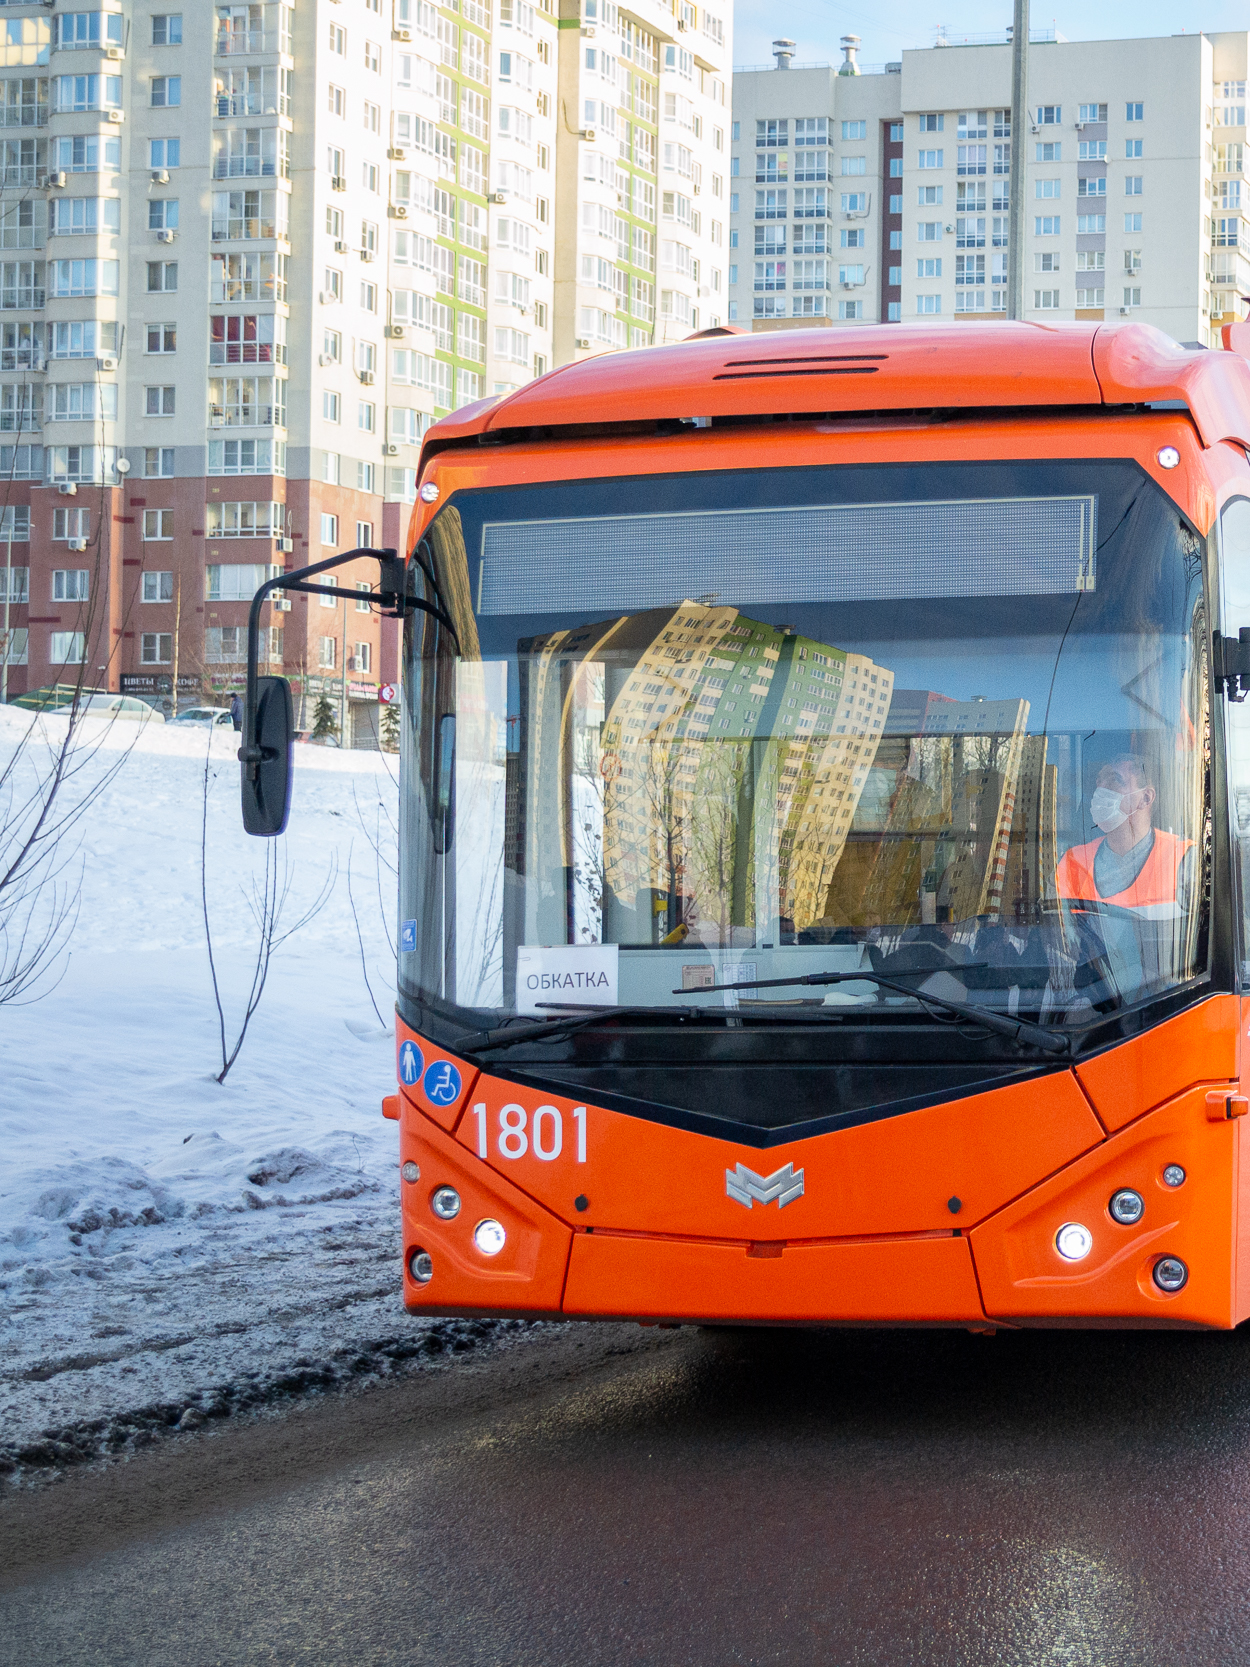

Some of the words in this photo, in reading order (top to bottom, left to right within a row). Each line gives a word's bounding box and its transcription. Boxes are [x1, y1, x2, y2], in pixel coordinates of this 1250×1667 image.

[124, 677, 154, 686] ЦВЕТЫ
[526, 971, 610, 991] ОБКАТКА
[472, 1102, 588, 1163] 1801
